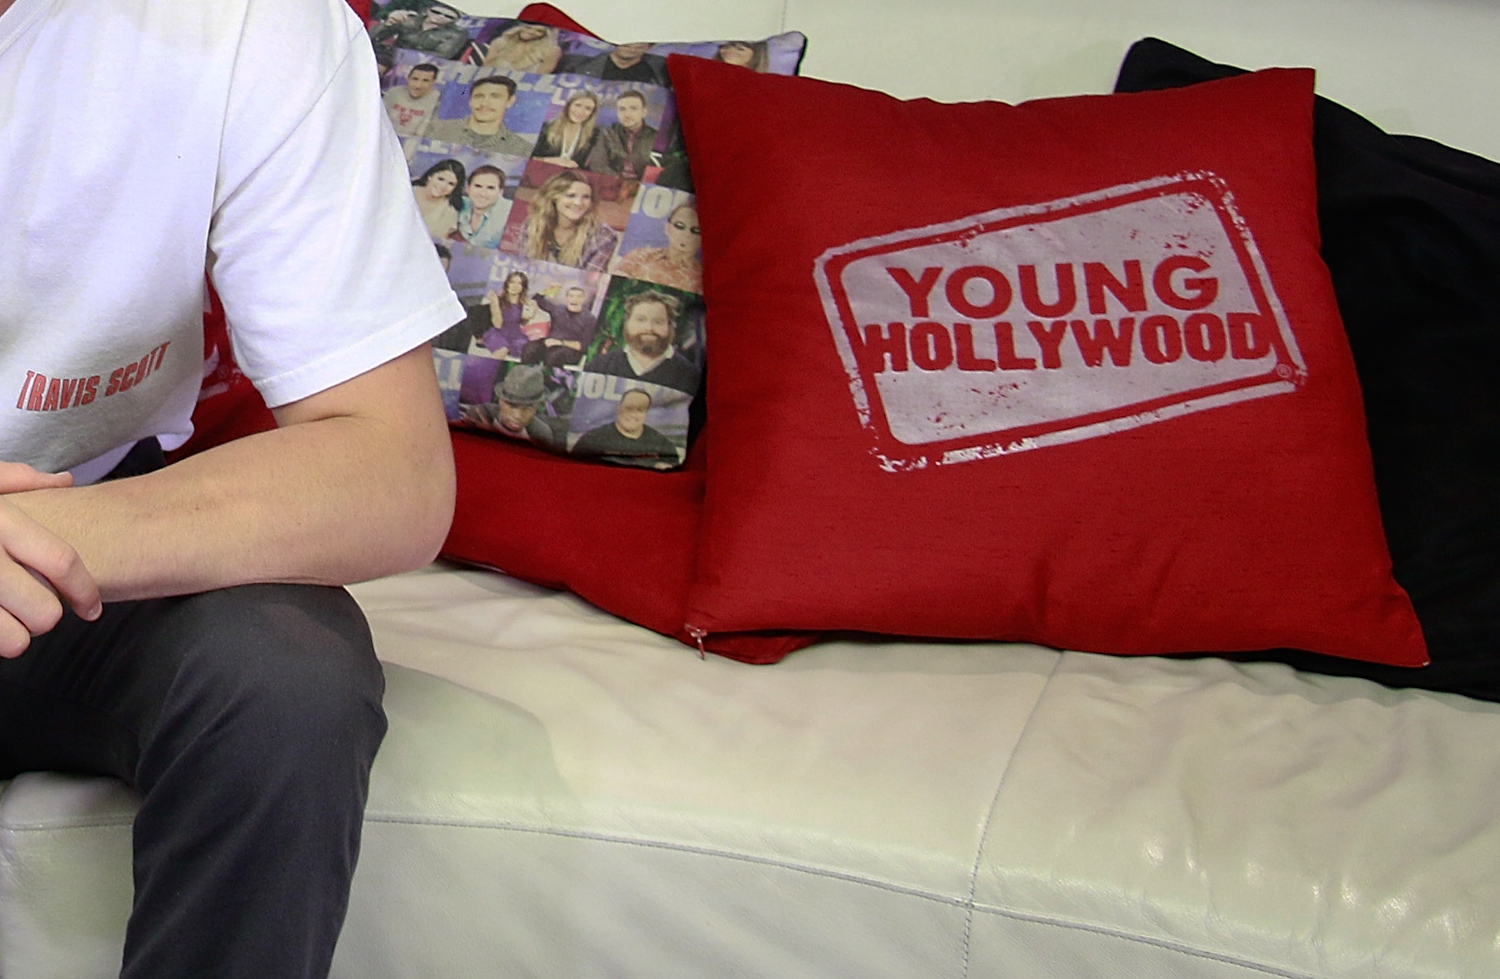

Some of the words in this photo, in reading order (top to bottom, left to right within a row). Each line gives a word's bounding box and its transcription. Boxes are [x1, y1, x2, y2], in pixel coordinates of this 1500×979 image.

[886, 255, 1218, 319] YOUNG
[862, 312, 1273, 373] HOLLYWOOD
[16, 370, 100, 411] TRAVIS
[105, 341, 171, 397] SCOTT
